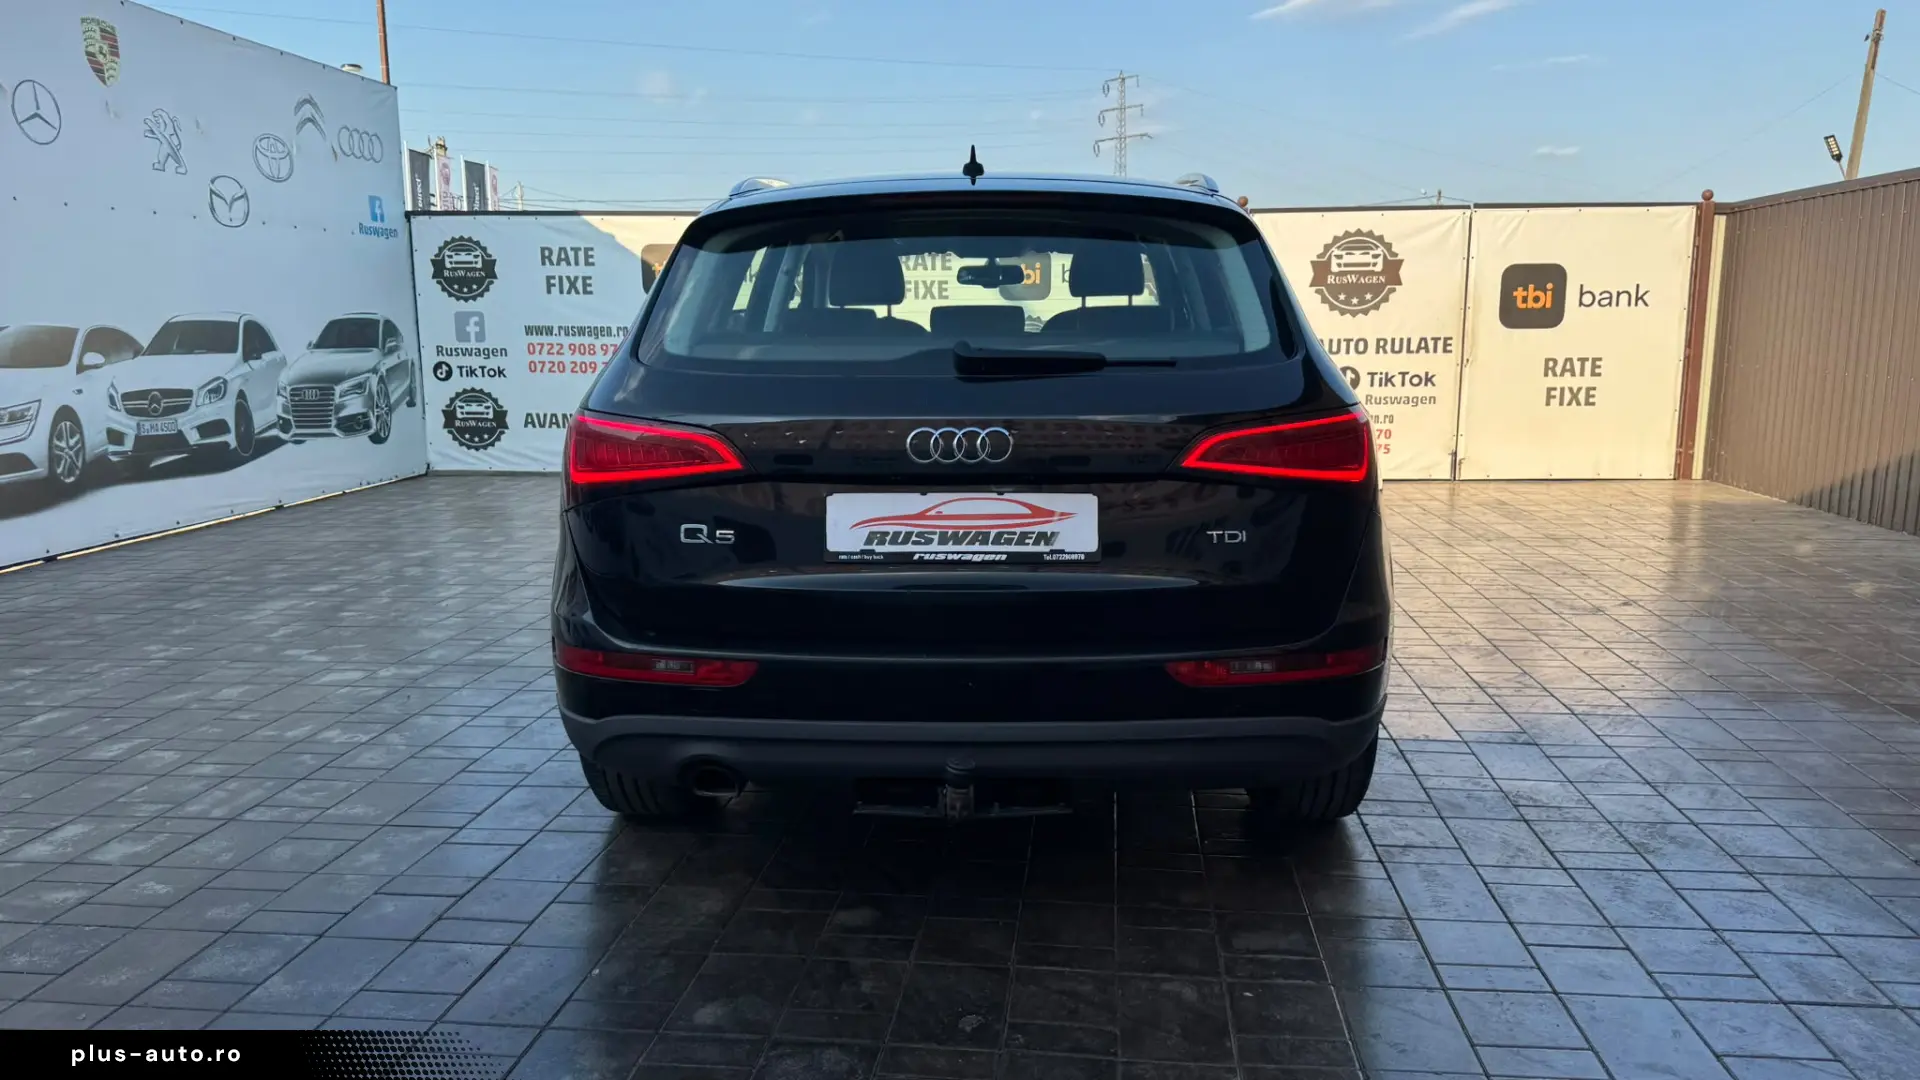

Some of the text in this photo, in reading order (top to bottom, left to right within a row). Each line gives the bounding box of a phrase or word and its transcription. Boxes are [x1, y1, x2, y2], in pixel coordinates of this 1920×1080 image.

[540, 246, 595, 267] RATE
[900, 253, 952, 271] RATE
[1021, 262, 1041, 285] bi
[545, 275, 594, 295] FIXE
[1513, 282, 1650, 309] tbi bank
[436, 345, 508, 360] Ruswagen
[527, 343, 564, 356] 0722
[568, 343, 597, 356] 908
[1375, 336, 1453, 355] RULATE
[457, 365, 507, 379] TikTok
[528, 361, 566, 373] 0720
[570, 361, 597, 373] 209
[1543, 357, 1603, 378] RATE
[1367, 371, 1436, 388] TikTok
[1366, 394, 1437, 408] Ruswagen
[1545, 386, 1597, 407] FIXE
[1376, 428, 1392, 439] 70
[680, 523, 735, 544] Q5
[863, 530, 1060, 547] RUSWAGEN
[1206, 530, 1246, 543] TDI
[913, 552, 1008, 562] ruswagen
